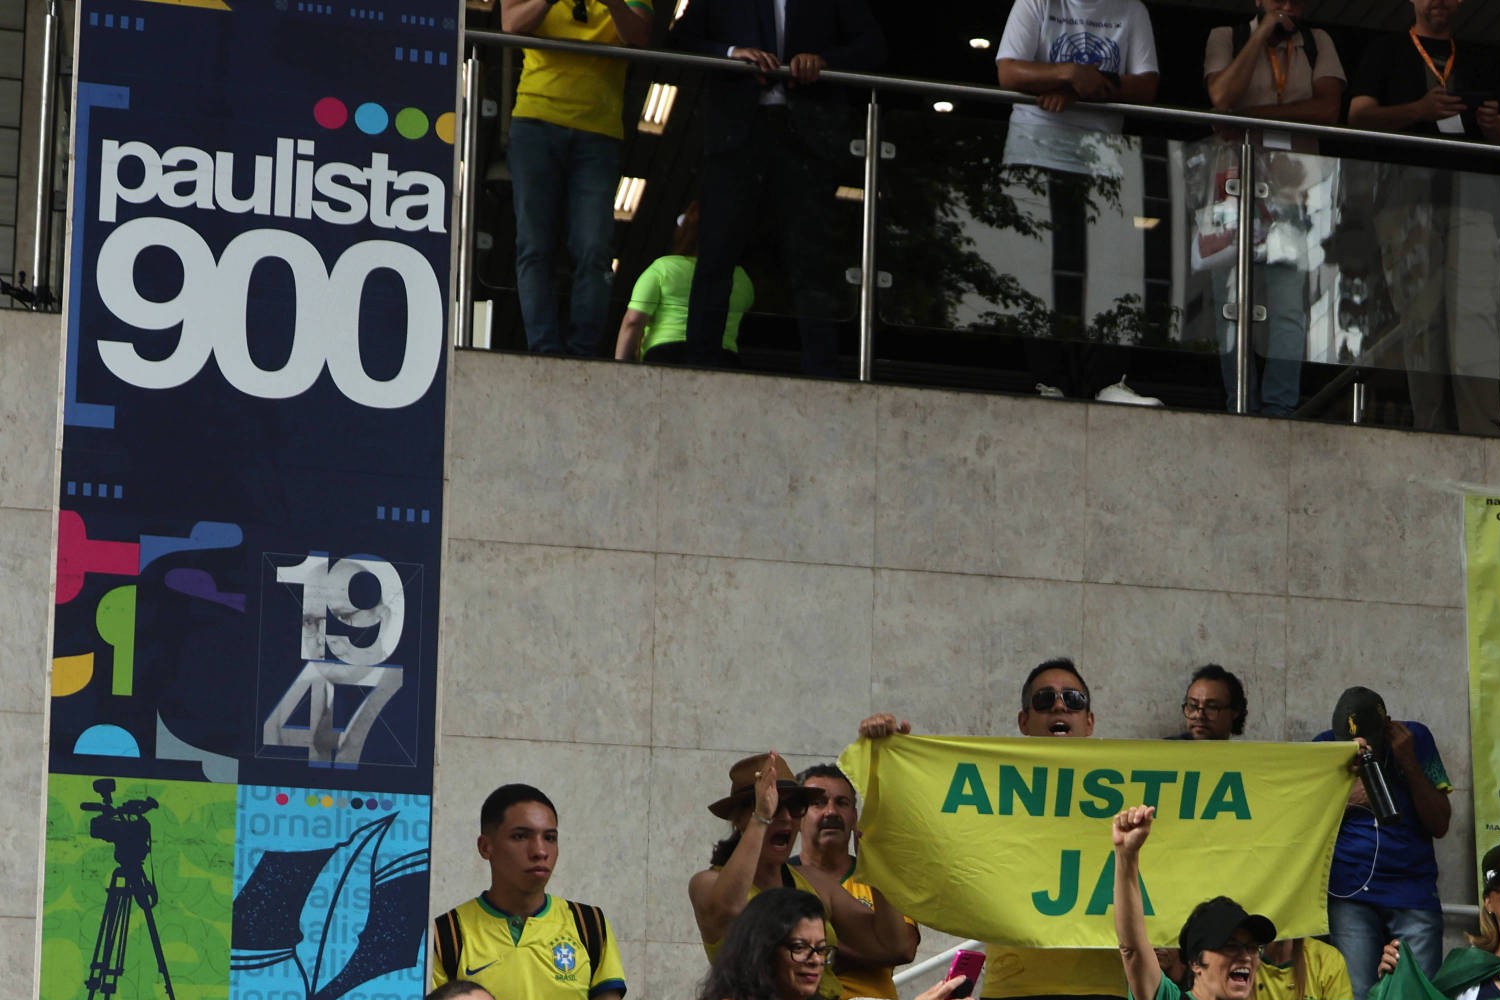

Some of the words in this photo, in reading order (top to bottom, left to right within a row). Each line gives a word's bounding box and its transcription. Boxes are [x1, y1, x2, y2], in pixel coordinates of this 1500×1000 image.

[99, 137, 447, 233] paulista
[96, 216, 443, 409] 900
[276, 552, 405, 666] 19
[263, 660, 404, 769] 47
[941, 763, 1253, 821] ANISTIA
